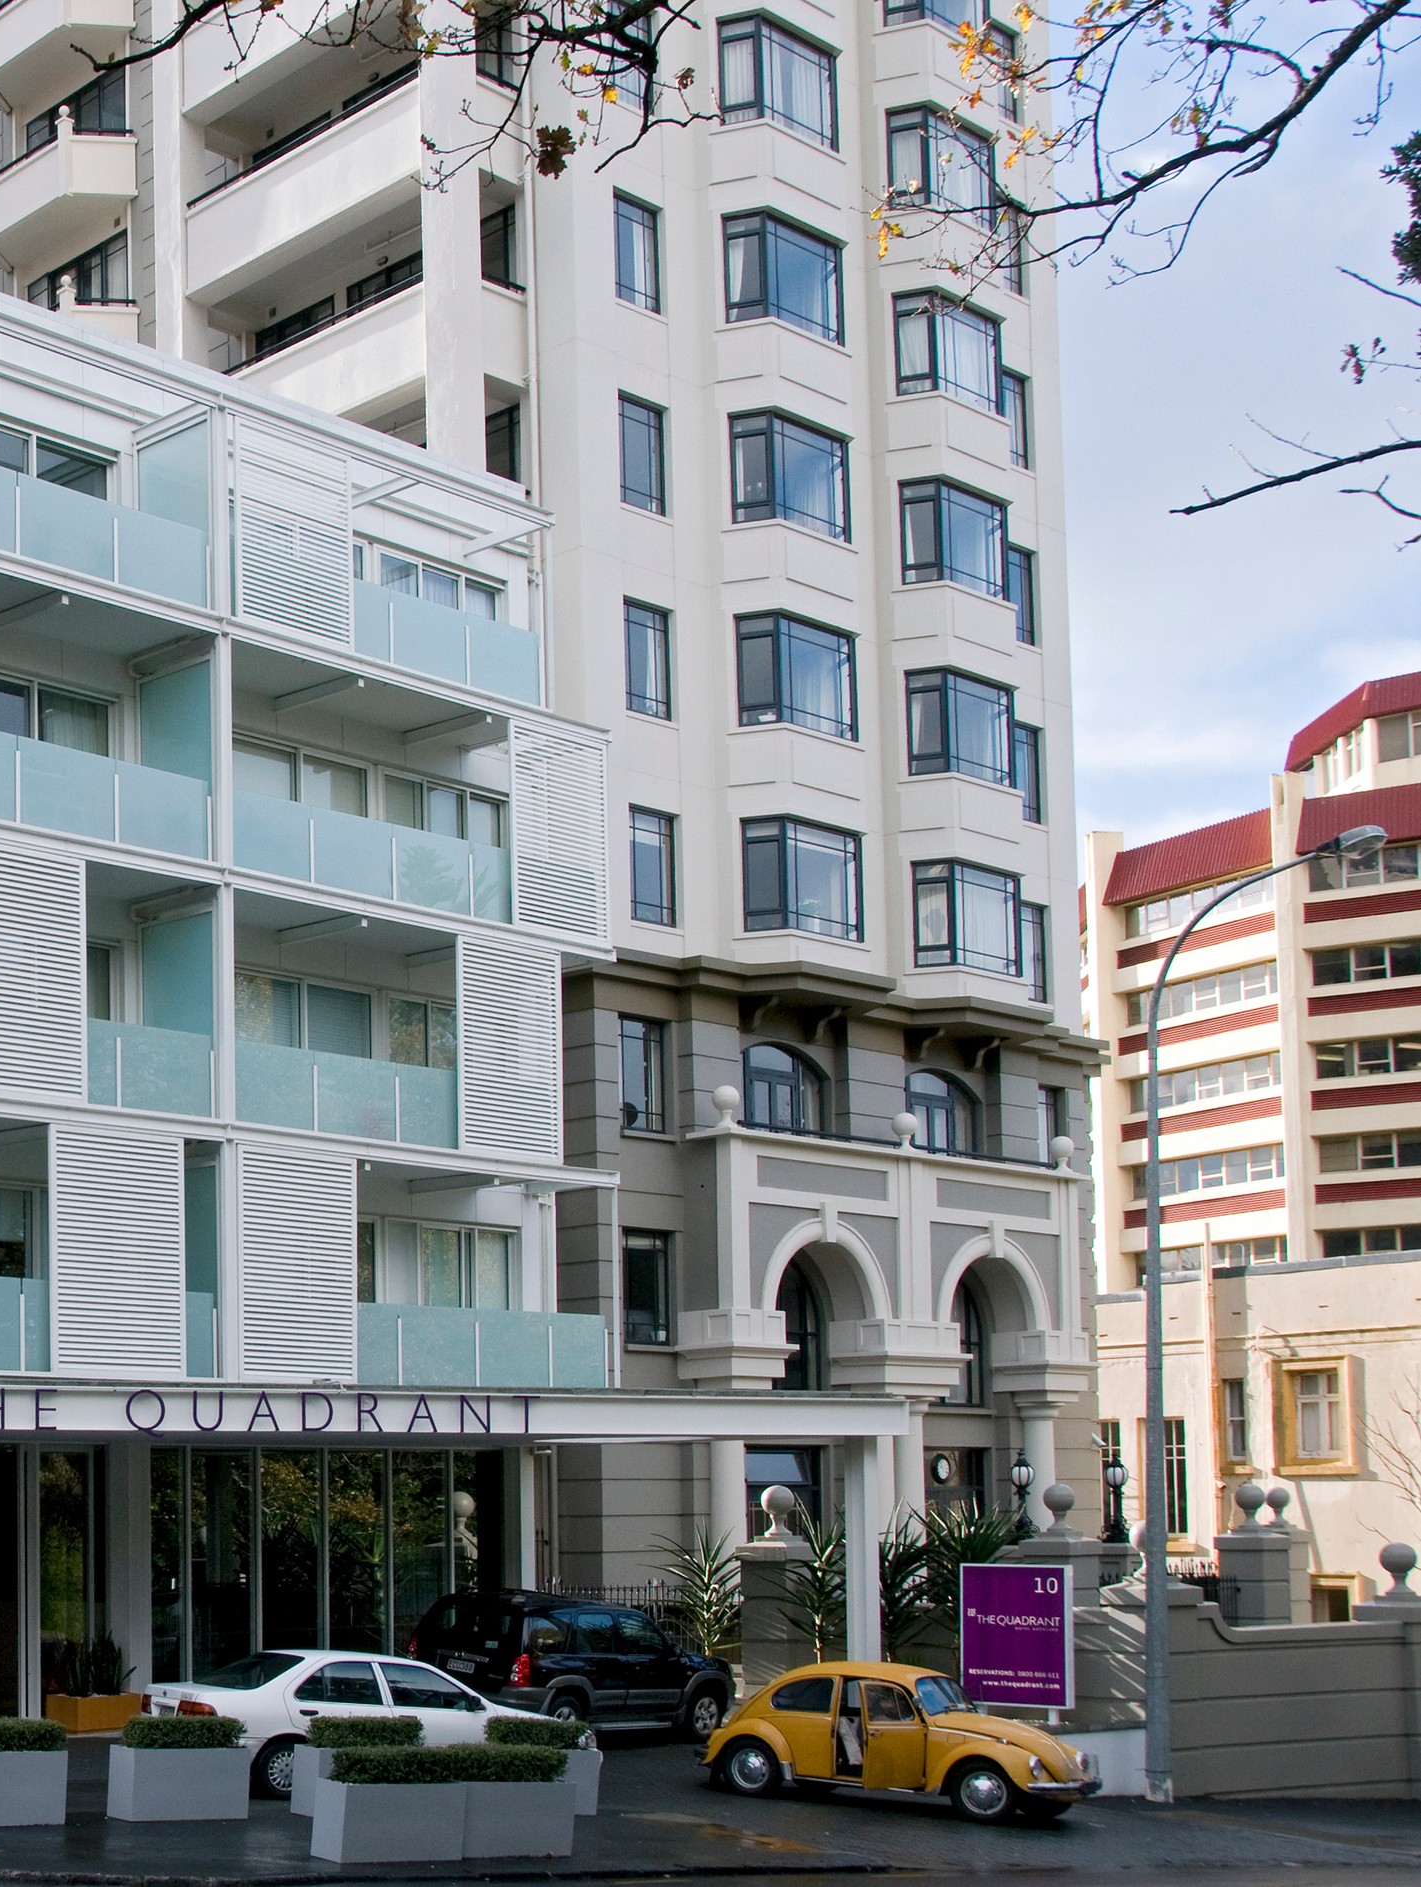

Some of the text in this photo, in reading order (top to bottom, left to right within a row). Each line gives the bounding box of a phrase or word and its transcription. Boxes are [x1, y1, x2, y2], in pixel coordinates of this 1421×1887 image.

[125, 1389, 541, 1437] QUADRANT
[1034, 1577, 1059, 1594] 10
[976, 1614, 1060, 1627] THE QUADRANT
[968, 1668, 1015, 1677] RESERVATIONS:
[1017, 1670, 1034, 1678] 0800
[981, 1680, 1060, 1690] www.thequadrant.com
